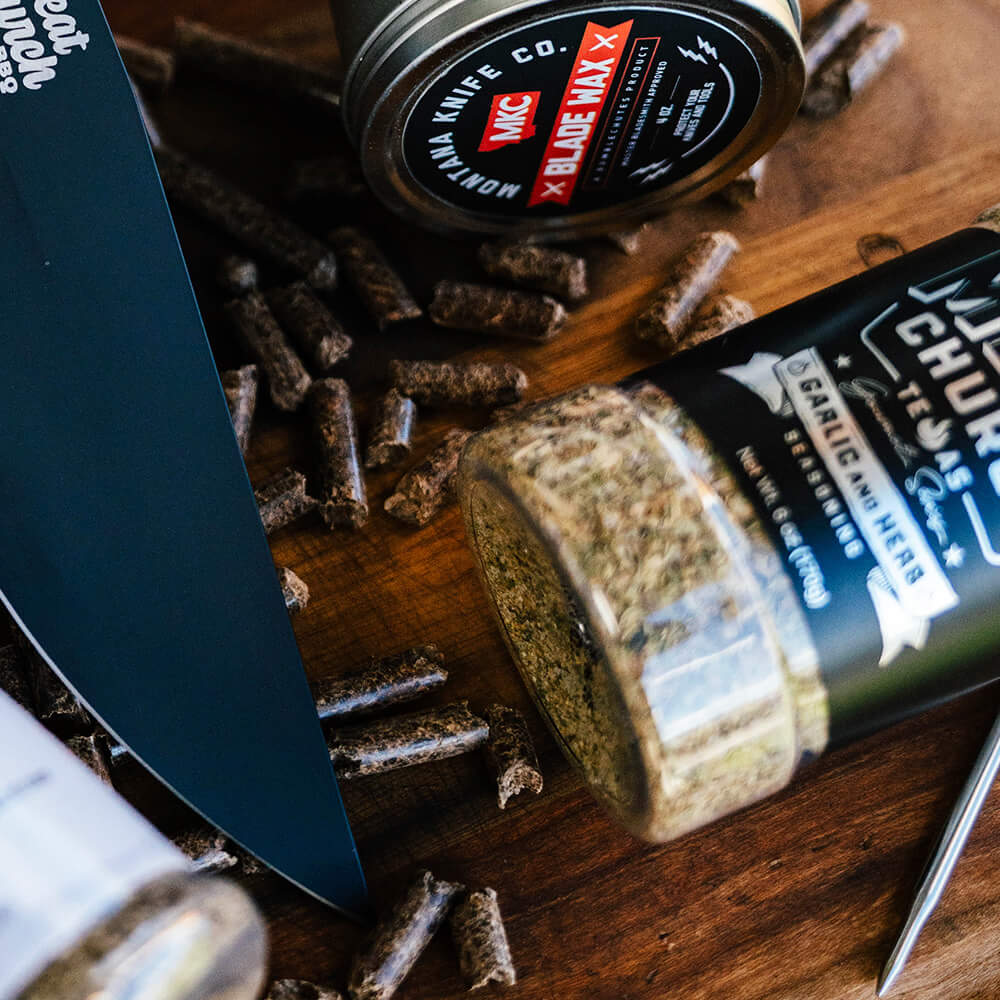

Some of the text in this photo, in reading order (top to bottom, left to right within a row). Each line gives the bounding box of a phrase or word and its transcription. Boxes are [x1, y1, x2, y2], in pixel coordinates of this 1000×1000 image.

[567, 58, 615, 106] WAX
[626, 46, 649, 92] PRODUCT
[698, 82, 716, 105] TOOLS
[428, 40, 567, 198] MONTANA KNIFE CO.
[489, 95, 532, 141] MKC
[631, 98, 654, 141] BLADESMITH
[648, 61, 668, 97] APPROVED
[673, 89, 701, 137] PROTECT YOUR
[544, 111, 596, 176] BLADE
[896, 311, 1000, 498] CHUR
[736, 446, 764, 478] Net
[800, 377, 859, 466] GARLIC
[847, 472, 878, 512] AND
[874, 513, 925, 585] HERB
[784, 429, 865, 560] SEASONING
